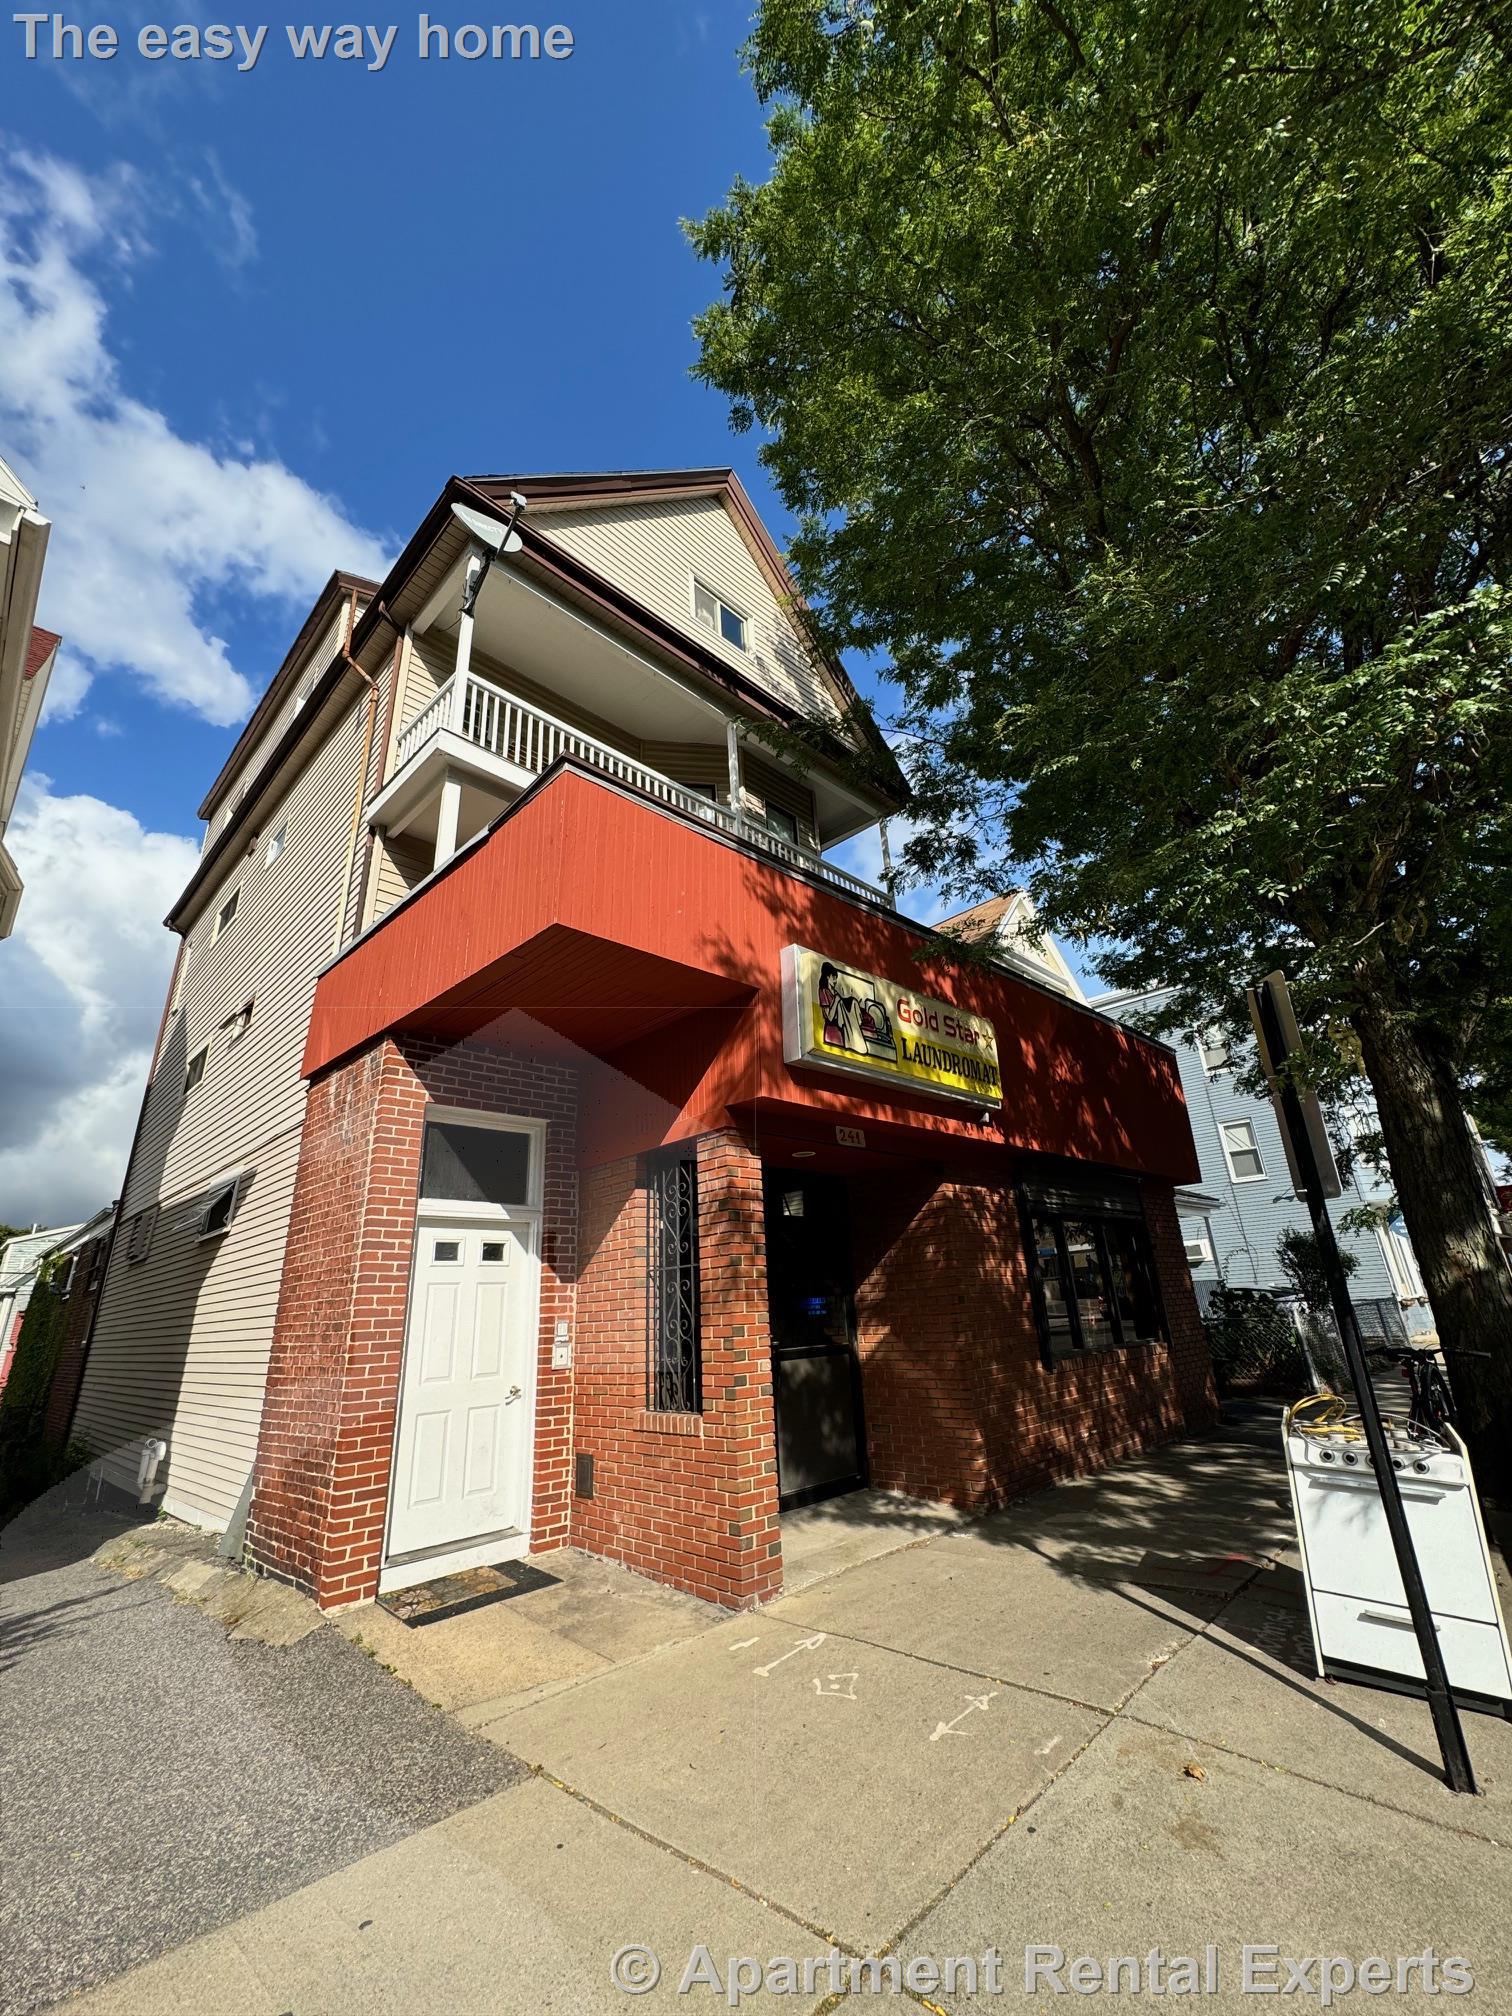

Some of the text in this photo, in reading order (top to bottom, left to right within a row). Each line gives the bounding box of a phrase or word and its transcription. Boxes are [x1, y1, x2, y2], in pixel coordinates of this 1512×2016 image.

[897, 998, 980, 1046] Gold Star
[901, 1037, 997, 1086] LAUNDROMAT
[839, 1128, 862, 1145] 241
